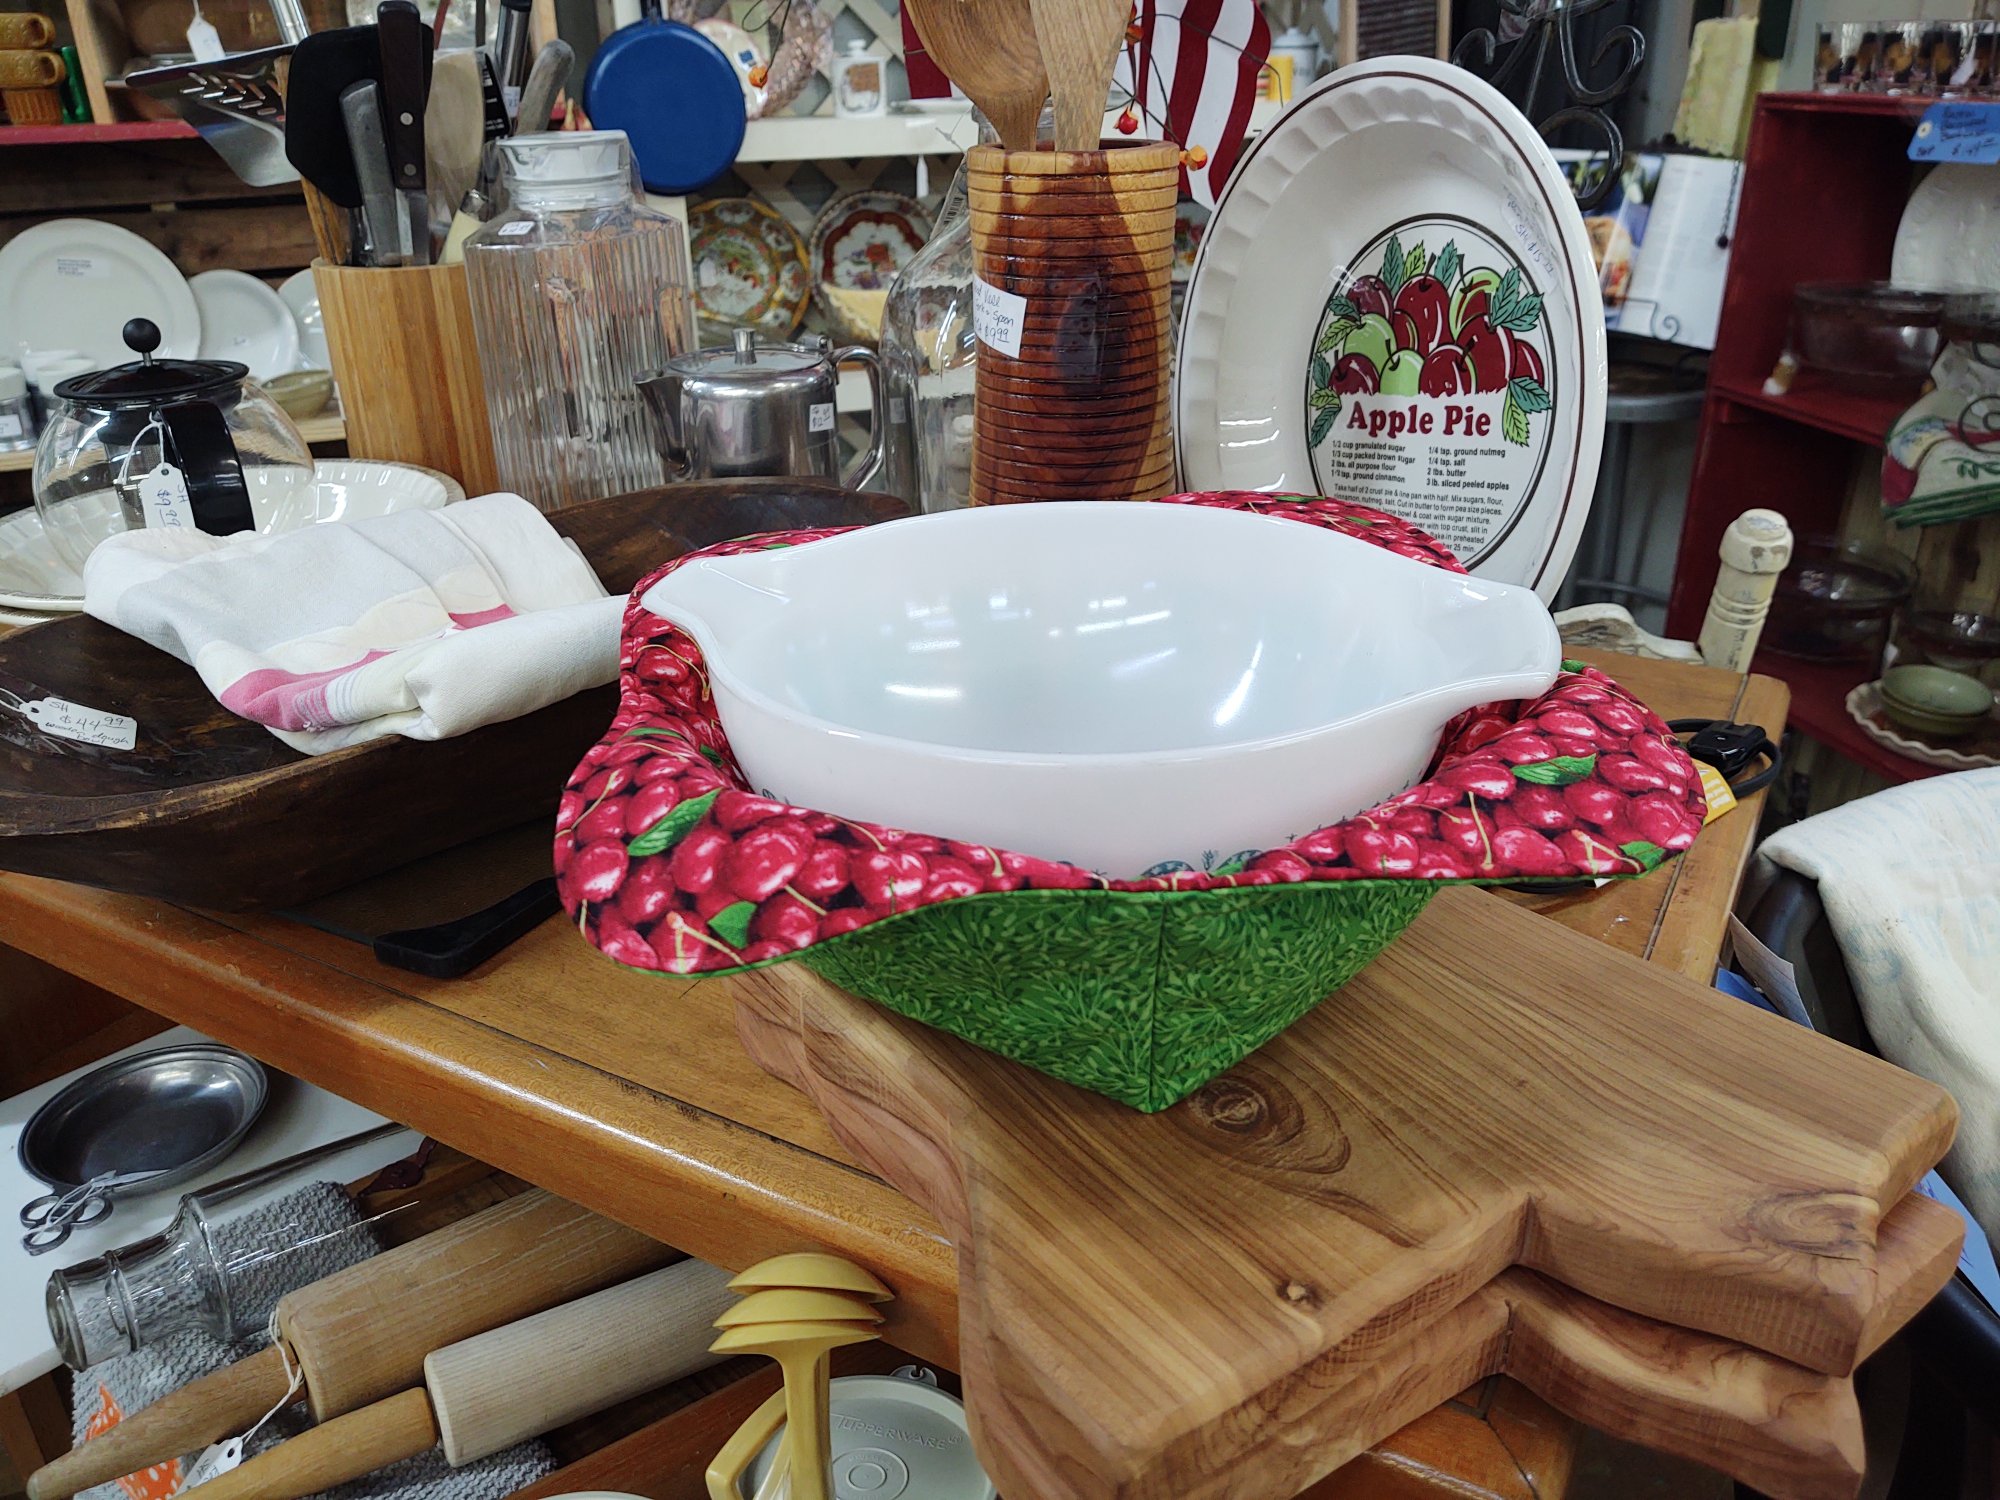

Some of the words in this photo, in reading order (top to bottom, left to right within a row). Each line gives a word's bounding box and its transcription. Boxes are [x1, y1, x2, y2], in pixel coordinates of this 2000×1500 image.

[1346, 401, 1433, 439] Apple
[1443, 405, 1491, 436] Pie
[1332, 440, 1341, 448] 1/2
[1342, 441, 1353, 449] cup
[1355, 441, 1387, 450] granulated
[1388, 443, 1406, 452] sugar
[1428, 446, 1438, 454] 1/4
[1454, 448, 1478, 457] ground
[1480, 448, 1506, 458] nutmeg
[1342, 451, 1353, 459] cup
[1354, 451, 1375, 460] packed
[1377, 452, 1396, 460] brown
[1397, 455, 1416, 465] sugar
[1453, 458, 1466, 466] salt
[1356, 462, 1380, 470] purpose
[1382, 462, 1396, 471] flour
[1427, 467, 1431, 475] 2
[1446, 468, 1467, 477] butter
[1353, 472, 1374, 480] ground
[1375, 473, 1406, 483] cinnamon
[1426, 478, 1430, 486] 3
[1441, 479, 1461, 488] sliced
[1462, 480, 1485, 490] peeled
[1486, 482, 1510, 491] apples
[1385, 488, 1393, 497] pie
[1394, 489, 1398, 497] &
[1399, 490, 1410, 498] line
[1411, 492, 1421, 500] pan
[1463, 496, 1486, 504] sugars,
[1487, 497, 1504, 506] flour,
[1397, 499, 1407, 507] Cut
[1433, 503, 1439, 511] to
[1455, 505, 1467, 513] pea
[1480, 507, 1503, 515] pieces.
[1397, 509, 1412, 517] bowl
[1412, 510, 1417, 518] &
[1433, 513, 1446, 521] with
[1447, 515, 1464, 523] sugar
[1465, 515, 1491, 525] mixture.
[1440, 523, 1451, 531] top
[1481, 526, 1488, 534] in
[1453, 535, 1485, 544] preheated
[1453, 543, 1461, 551] 25
[1462, 545, 1476, 553] min.
[49, 701, 69, 713] SH
